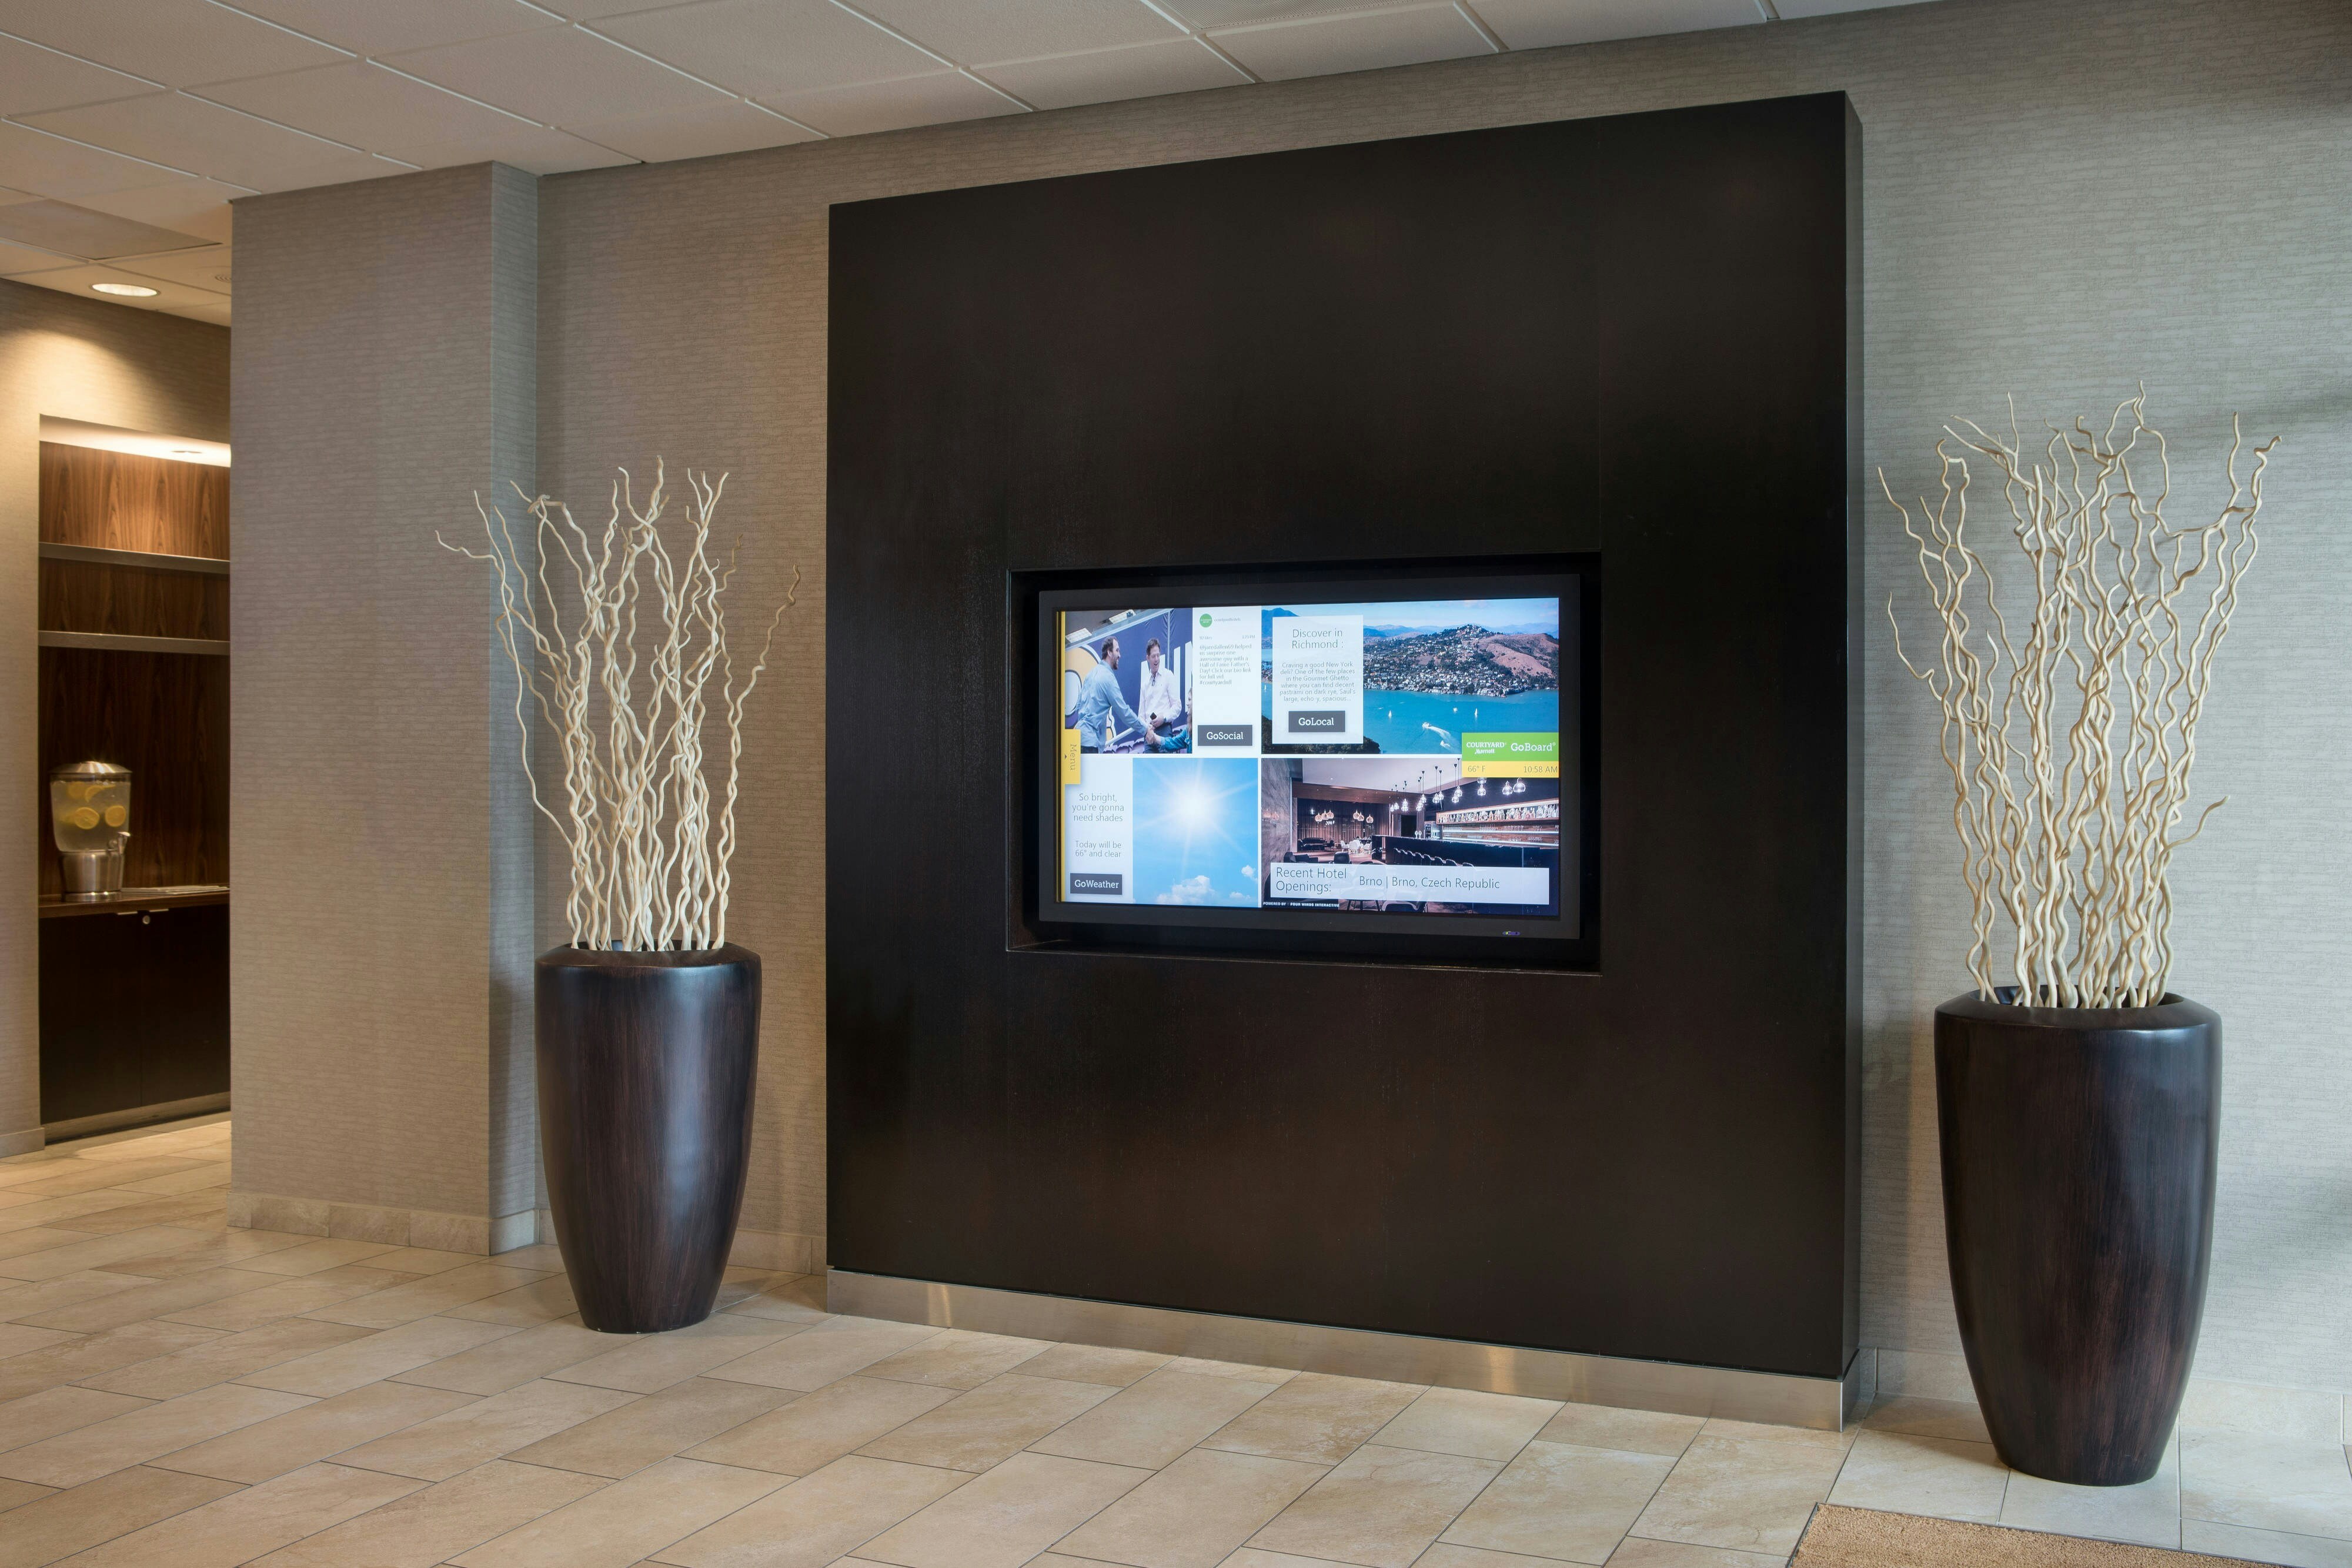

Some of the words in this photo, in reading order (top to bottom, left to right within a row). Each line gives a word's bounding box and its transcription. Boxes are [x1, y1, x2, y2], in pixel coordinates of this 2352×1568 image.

[1292, 629, 1331, 638] Discover
[1335, 628, 1342, 637] in
[1292, 640, 1338, 648] Richmond
[1298, 717, 1334, 726] GoLocal
[1092, 793, 1117, 803] bright,
[1073, 804, 1096, 813] you're
[1099, 805, 1124, 813] gonna
[1096, 813, 1122, 821] shades
[1075, 841, 1097, 850] Today
[1277, 867, 1312, 878] Recent
[1317, 868, 1347, 878] Hotel
[1075, 880, 1119, 888] GoWeather
[1276, 881, 1331, 894] Openings:
[1359, 876, 1382, 885] Brno
[1392, 877, 1418, 888] Brno,
[1422, 877, 1451, 887] Czech
[1456, 878, 1500, 890] Republic
